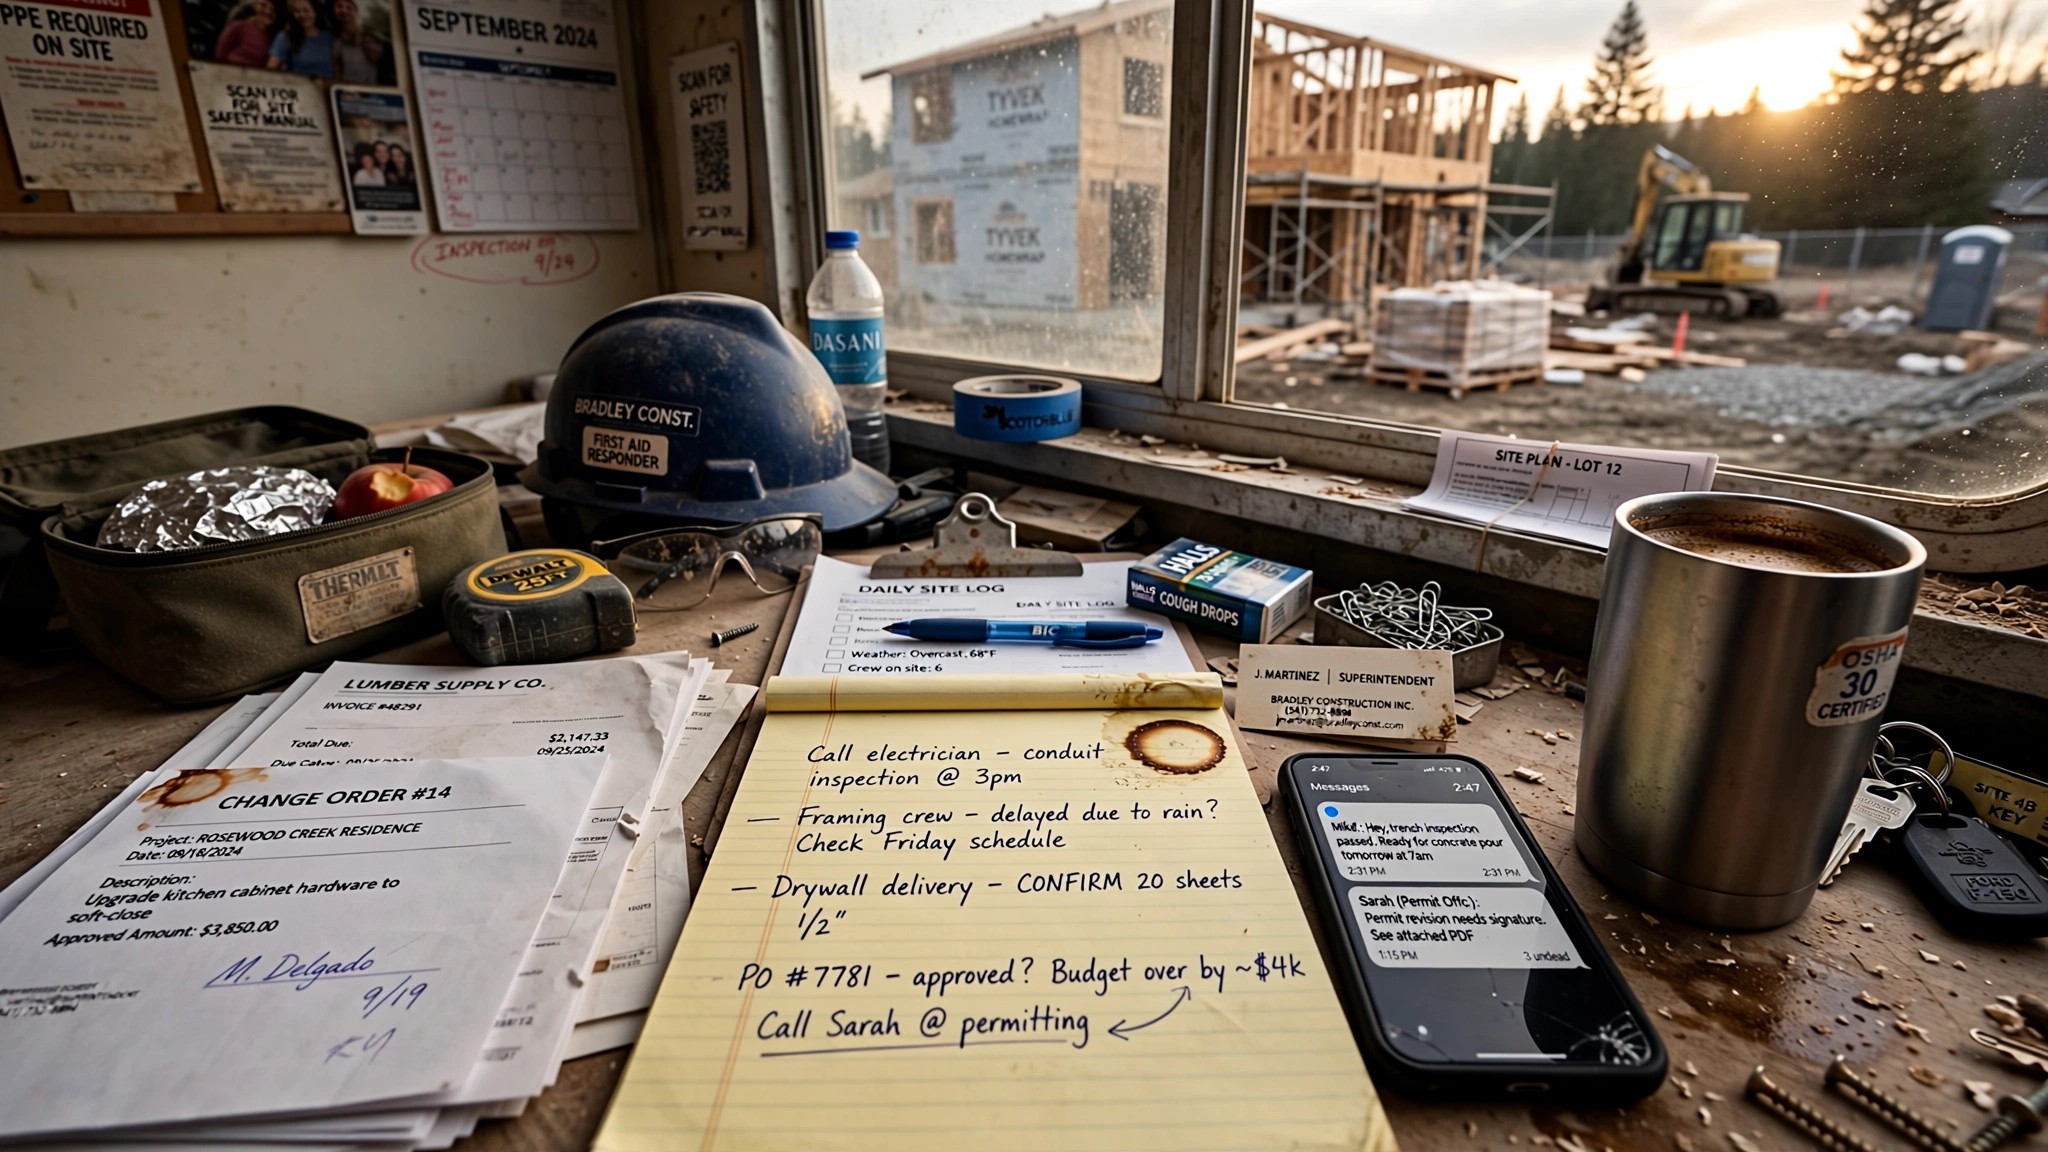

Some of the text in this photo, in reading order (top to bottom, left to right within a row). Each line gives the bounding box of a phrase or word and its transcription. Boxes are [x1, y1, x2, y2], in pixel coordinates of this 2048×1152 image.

[0, 4, 149, 40] PPE REQUIRED
[417, 7, 598, 49] SEPTEMBER 2024
[32, 33, 114, 62] ON SITE
[678, 63, 732, 92] SCAN FOR
[226, 84, 267, 99] SCAN
[986, 82, 1045, 112] TYVEK
[267, 101, 296, 115] SITE
[689, 92, 728, 119] SAFETY
[208, 109, 318, 129] SAFETY MANUAL
[985, 227, 1041, 247] TYVEK
[435, 239, 531, 262] INSPECTION
[813, 330, 880, 352] DASANI
[574, 398, 694, 428] BRADLEY CONST.
[593, 433, 651, 453] FIRST AID
[588, 447, 660, 470] RESPONDER
[1495, 449, 1622, 476] SITE PLAN LOT 12
[1159, 544, 1220, 575] HALLS
[488, 559, 567, 584] DEWALT
[859, 585, 1005, 594] DAILY SITE LOG
[1159, 591, 1198, 615] COUGH
[1200, 603, 1239, 627] DROPS
[1032, 625, 1060, 636] BIC
[852, 649, 996, 660] Weather: Overcast, 68°F
[1842, 644, 1898, 668] OSHA
[848, 663, 943, 673] Crew on site: 6
[1254, 669, 1435, 686] J. MARTINEZ SUPERINTENDENT
[343, 678, 547, 691] LUMBER SUPPLY CO.
[1840, 668, 1878, 699] 30
[323, 702, 422, 711] INVOICE #48291
[1271, 695, 1414, 711] BRADLEY CONSTRUCTION INC.
[290, 739, 323, 749] Total
[324, 739, 354, 749] Due:
[537, 745, 605, 756] 09/25/2024
[807, 743, 1105, 763] Call electrician conduit
[810, 767, 1022, 794] inspection @ 3pm
[1310, 782, 1480, 794] Messages 2:47
[218, 786, 452, 810] CHANGE ORDER #14
[1974, 782, 2038, 812] SITE 4B
[797, 799, 1218, 835] Framing crew delayed due to rain?
[1988, 804, 2028, 825] KEY
[139, 822, 423, 849] Project: ROSEWOOD CREEK RESIDENCE
[1366, 822, 1479, 836] Hey, trench inspection
[796, 830, 1066, 861] Check Friday schedule
[1336, 836, 1503, 849] passed. Ready for concrete pour
[125, 848, 165, 861] Date:
[1341, 850, 1434, 861] tomorrow at 7am
[1347, 866, 1386, 876] 2:31 PM
[99, 875, 196, 891] Description:
[771, 869, 1243, 908] Drywall delivery CONFIRM 20 sheets
[1966, 876, 2016, 887] FORD
[84, 876, 401, 908] Upgrade kitchen cabinet hardware to
[1967, 887, 2031, 901] F-150
[1359, 895, 1481, 910] Sarah (Permit Offc):
[67, 907, 154, 924] soft-close
[1365, 911, 1547, 927] Permit revision needs signature.
[44, 920, 280, 947] Approved Amount: $3,850.00
[1370, 929, 1475, 942] See attached PDF
[1379, 950, 1399, 960] 1:15
[1401, 951, 1418, 961] PM
[1523, 951, 1532, 961] 3
[205, 947, 376, 991] M. Delgado
[737, 965, 773, 991] PO
[785, 964, 872, 989] #7781
[913, 956, 1034, 1000] approved?
[1052, 958, 1132, 996] Budget
[1144, 962, 1188, 982] over
[1200, 955, 1226, 993] by
[363, 976, 428, 1019] 9/19
[757, 1005, 1090, 1049] Call Sarah @ permitting
